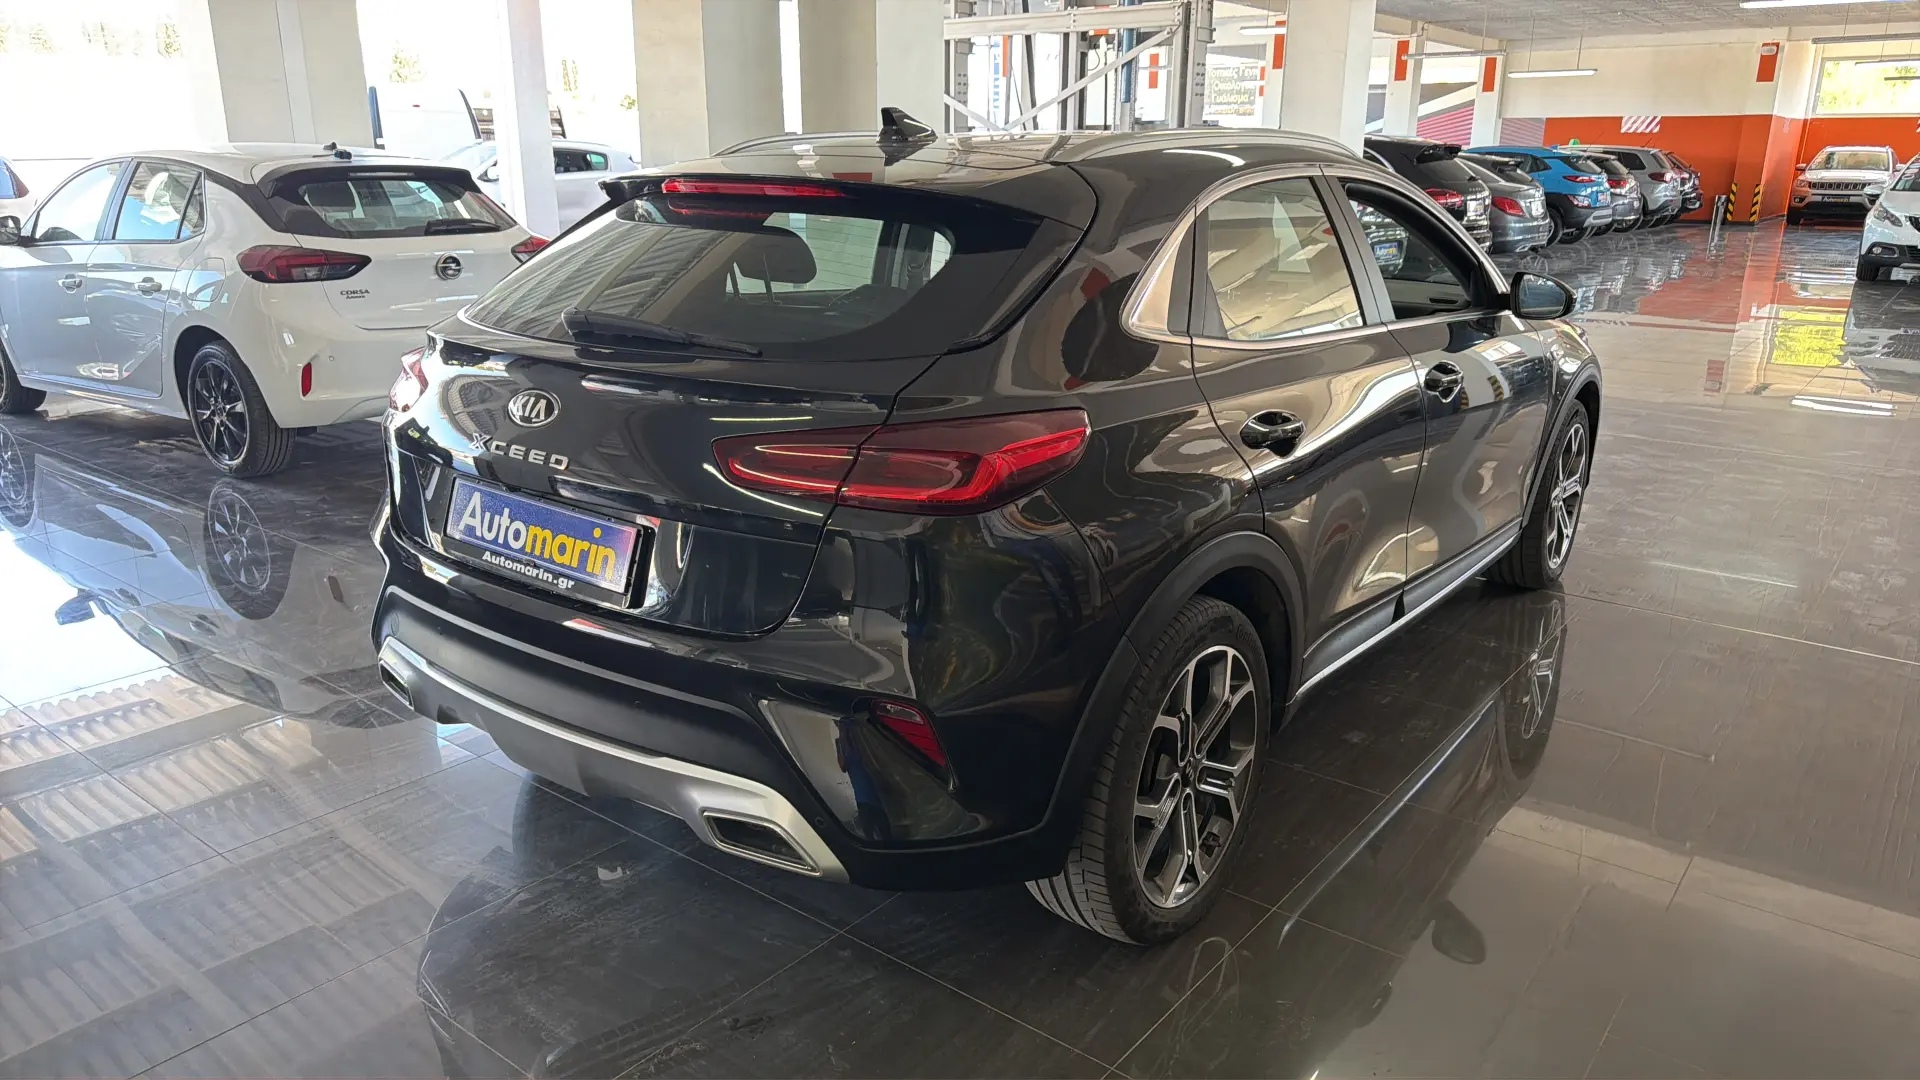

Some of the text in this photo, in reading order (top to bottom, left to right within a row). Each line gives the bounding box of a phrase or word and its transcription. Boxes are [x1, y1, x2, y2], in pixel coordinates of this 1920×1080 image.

[340, 288, 370, 296] CORSA
[511, 395, 547, 422] KIA
[470, 433, 570, 470] XCEED
[458, 491, 616, 580] Automarin
[482, 551, 575, 589] Automarin.gr
